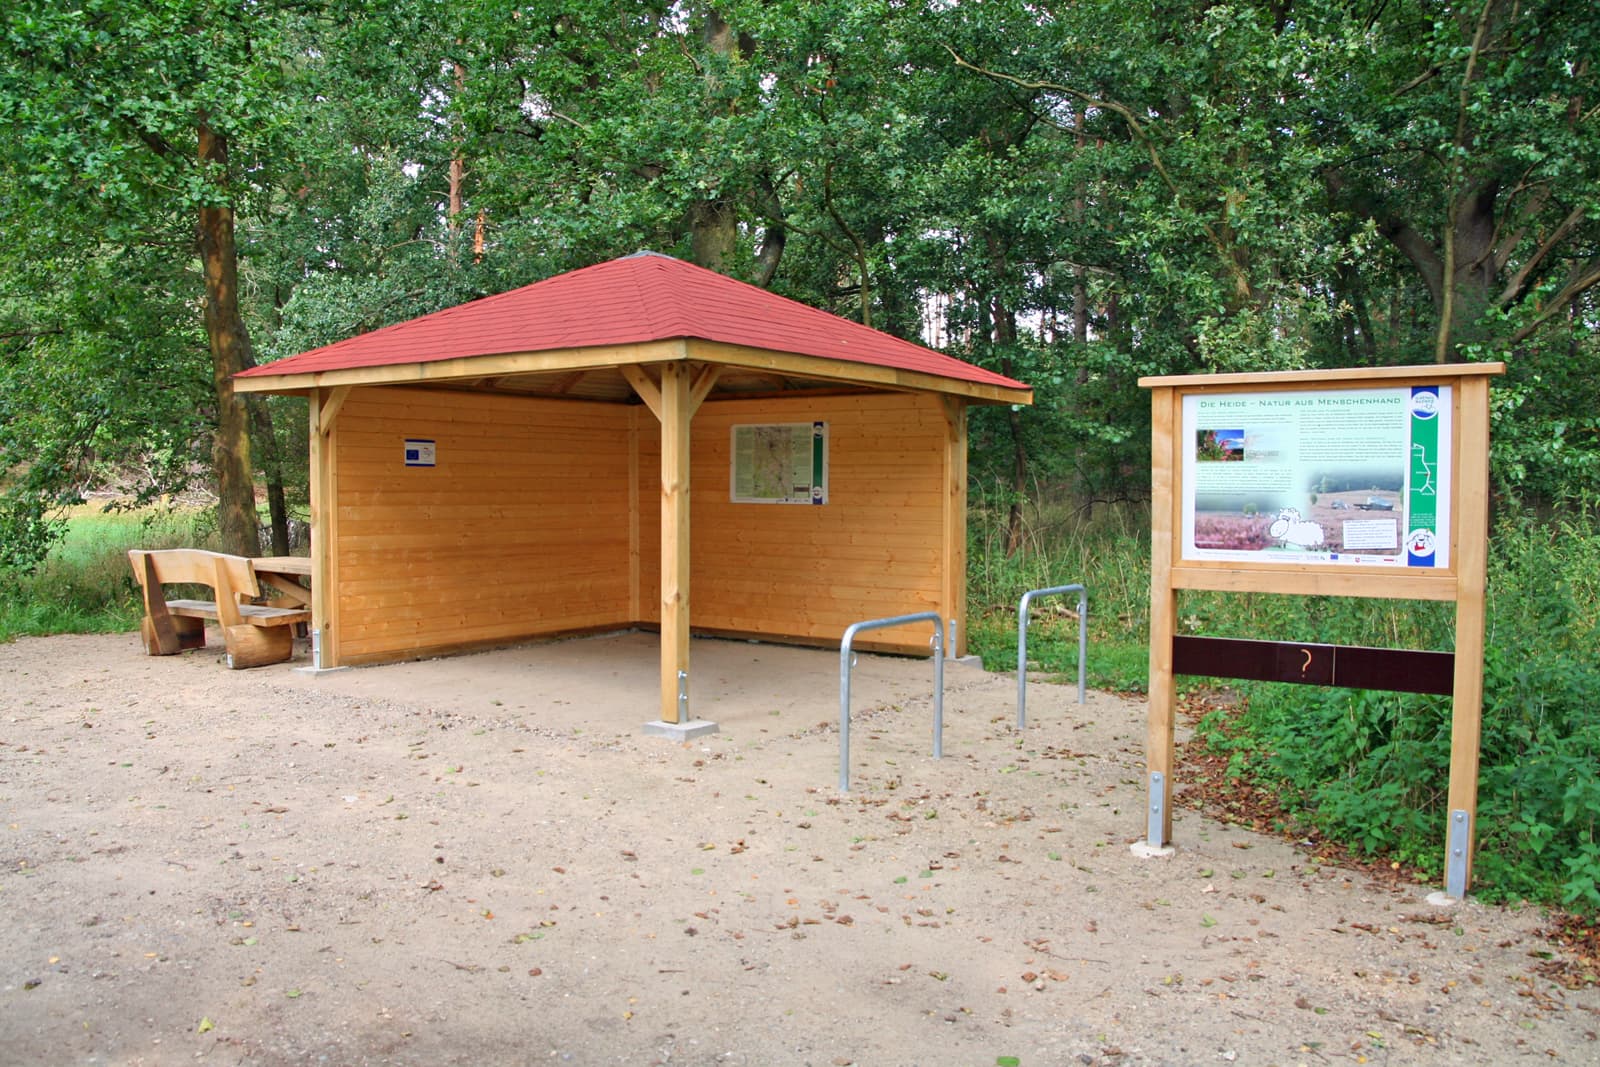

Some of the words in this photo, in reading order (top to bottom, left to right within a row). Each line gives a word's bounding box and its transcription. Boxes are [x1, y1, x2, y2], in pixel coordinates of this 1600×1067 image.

[1200, 400, 1216, 408] DIE
[1219, 400, 1248, 408] HEIDE
[1318, 397, 1400, 406] MENSCHENHAND
[1301, 648, 1312, 679] ?
